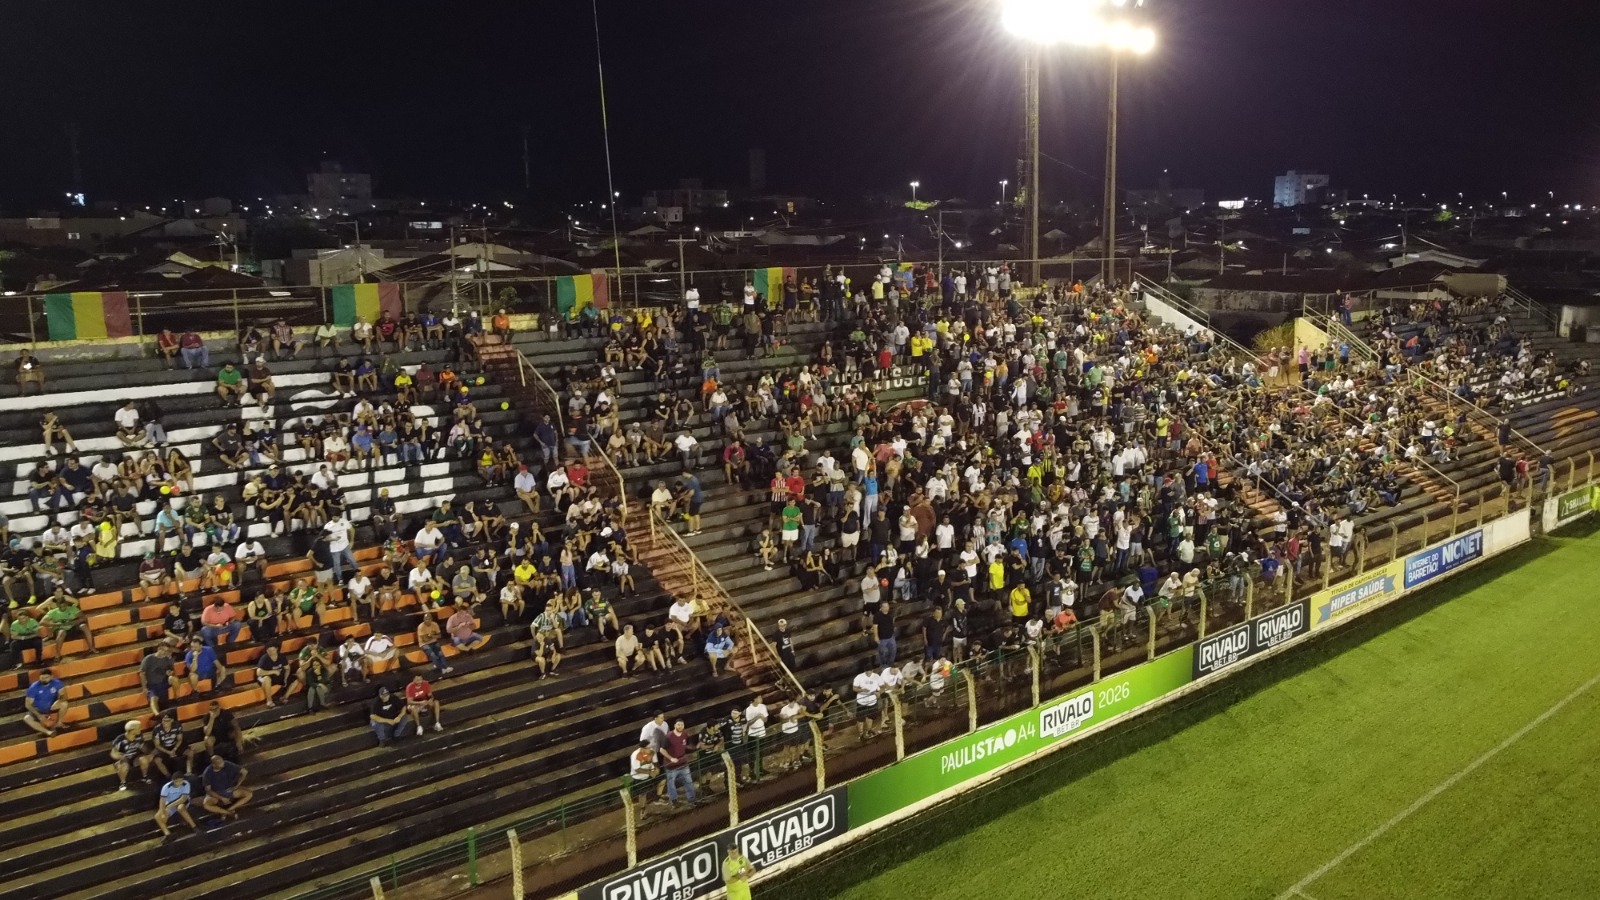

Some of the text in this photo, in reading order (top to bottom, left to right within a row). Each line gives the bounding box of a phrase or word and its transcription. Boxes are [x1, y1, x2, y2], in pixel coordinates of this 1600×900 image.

[1442, 531, 1482, 565] NICNET
[1331, 590, 1357, 612] HIPER
[1357, 578, 1385, 600] SAÚDE
[1259, 609, 1301, 641] RIVALO
[1202, 631, 1247, 665] RIVALO
[1098, 681, 1130, 709] 2026
[1043, 697, 1092, 732] RIVALO
[1017, 721, 1036, 743] A4
[741, 804, 829, 861] RIVALO
[610, 852, 712, 900] RIVALO
